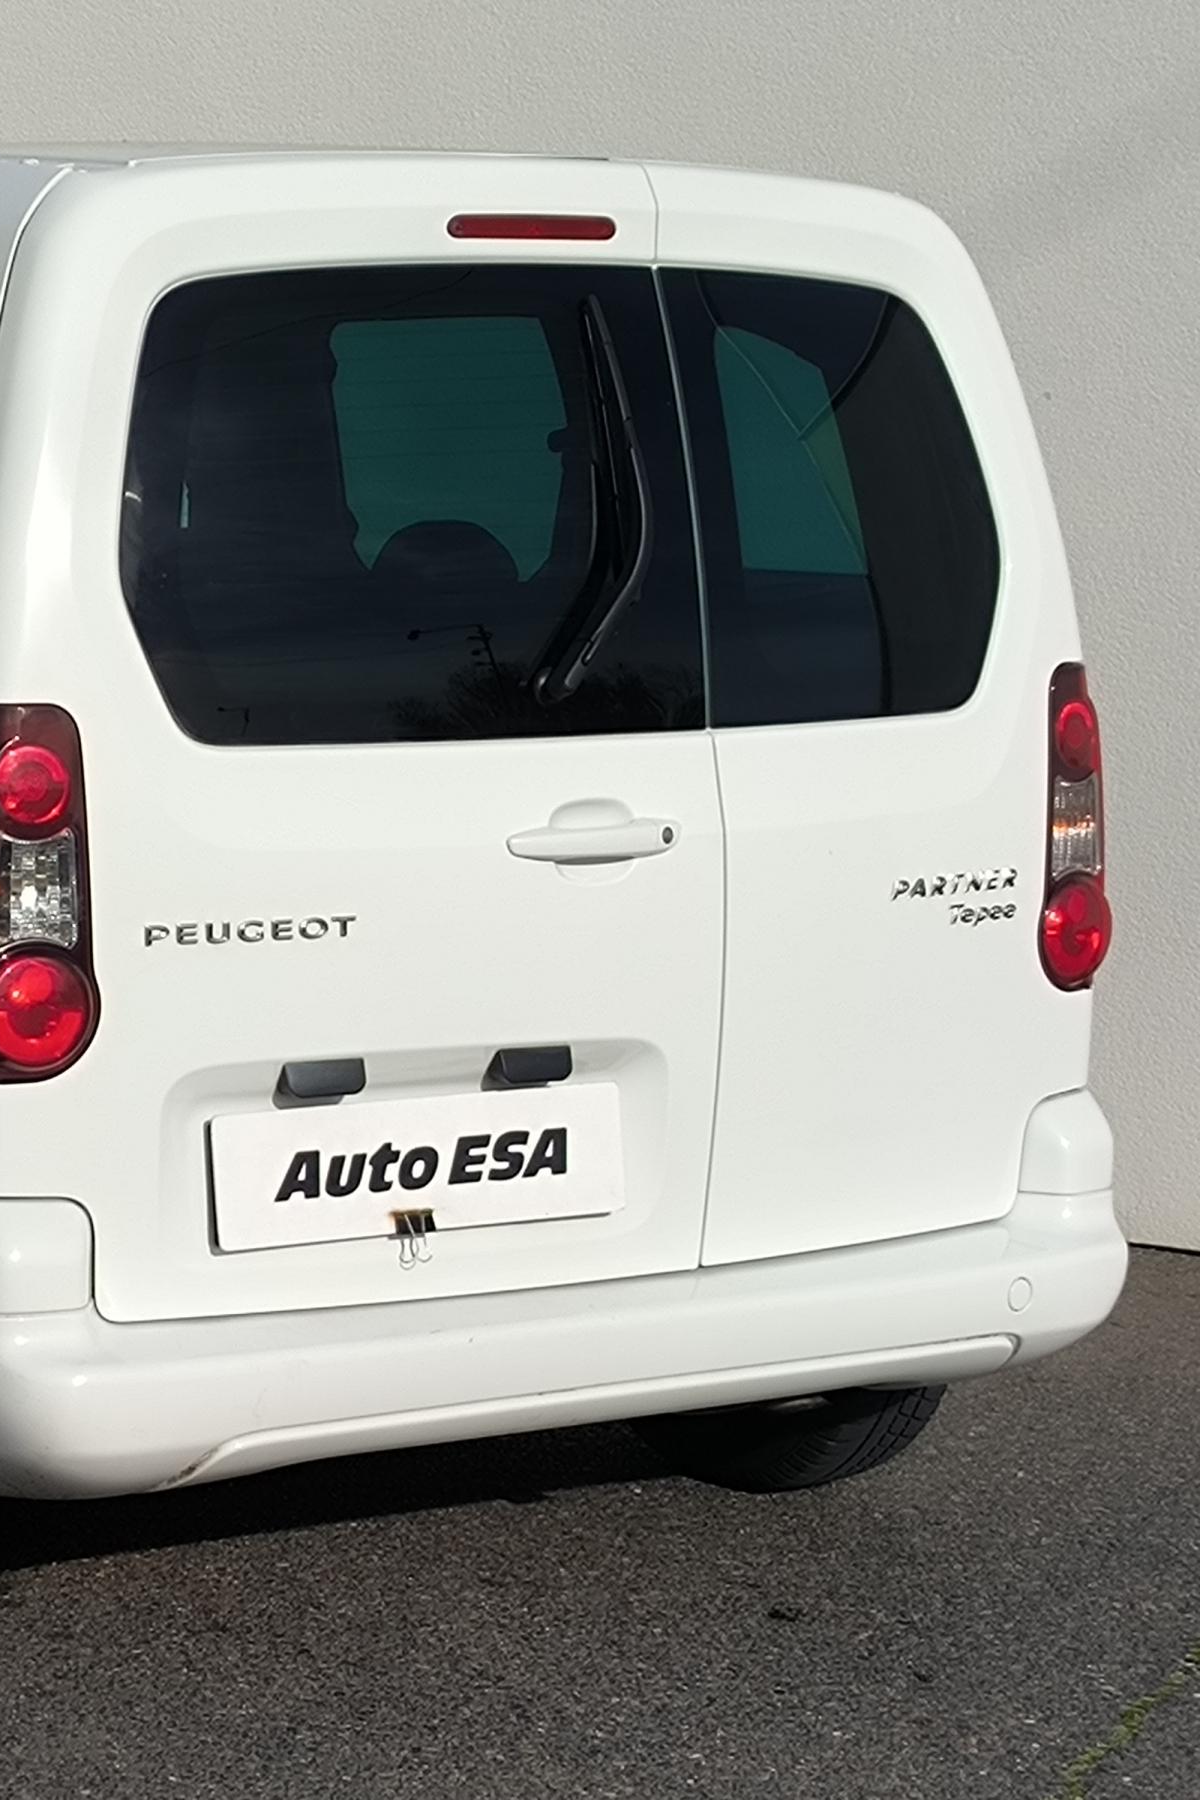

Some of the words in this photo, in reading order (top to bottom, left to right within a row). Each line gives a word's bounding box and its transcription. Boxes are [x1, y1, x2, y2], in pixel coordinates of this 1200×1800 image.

[892, 868, 1018, 901] PARTNER
[144, 915, 357, 947] PEUGEOT
[949, 903, 1017, 927] Tepee
[274, 1142, 439, 1202] Auto
[448, 1127, 568, 1185] ESA
